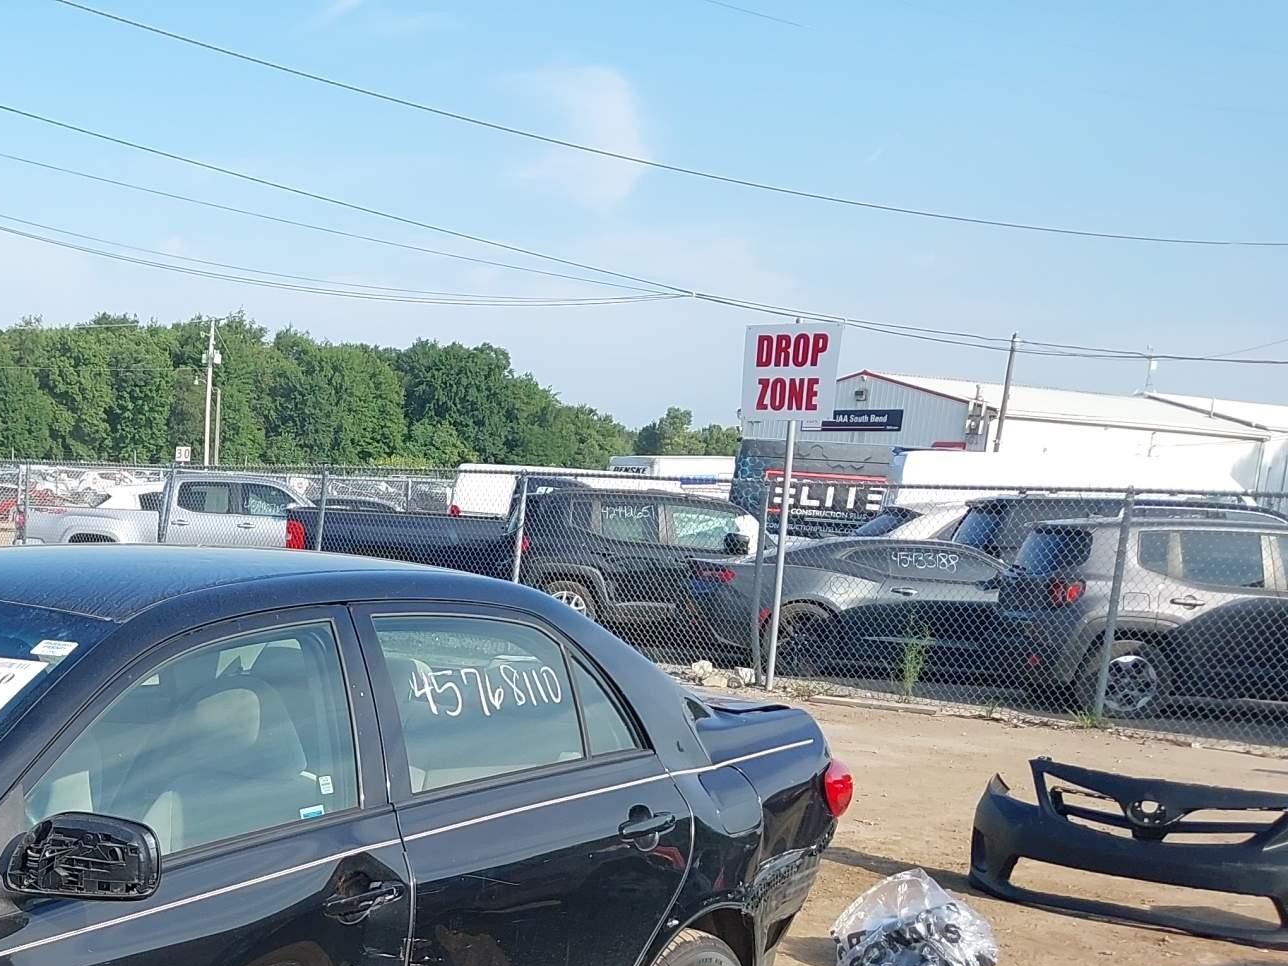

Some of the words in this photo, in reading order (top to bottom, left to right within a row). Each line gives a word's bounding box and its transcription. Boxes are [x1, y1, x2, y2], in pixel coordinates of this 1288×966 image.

[756, 333, 829, 367] DROP
[756, 377, 820, 411] ZONE
[835, 414, 848, 423] IAA
[849, 414, 869, 423] South
[870, 414, 888, 423] Bend
[176, 448, 190, 459] 30
[613, 466, 648, 475] PENSKE
[773, 477, 885, 511] ELITE
[790, 508, 848, 519] CONSTRUCTION
[850, 512, 867, 520] PLUS
[409, 664, 562, 716] 45768110
